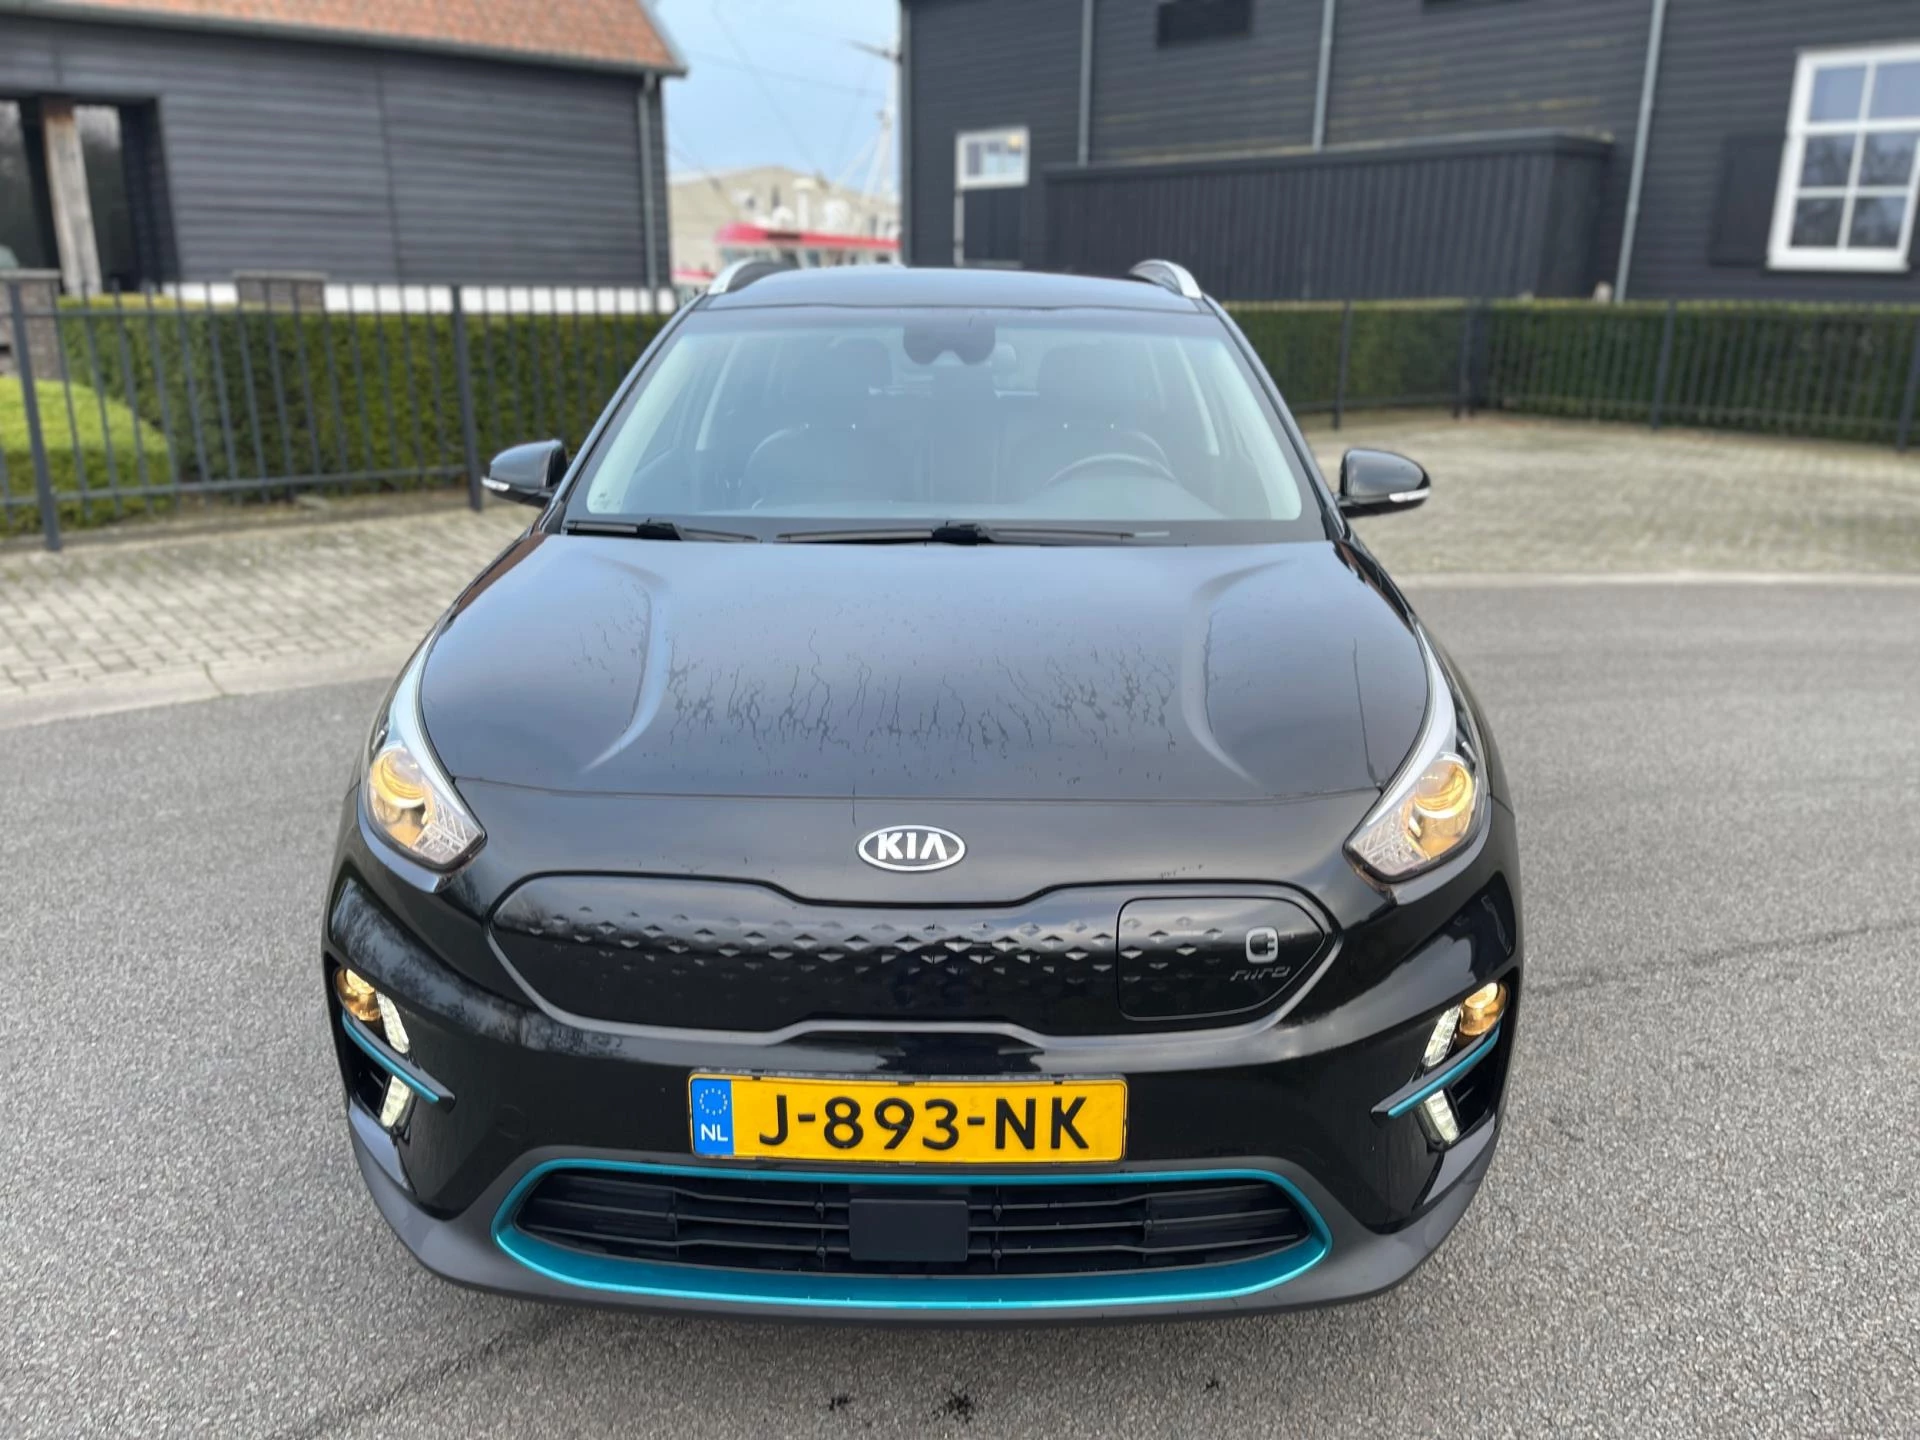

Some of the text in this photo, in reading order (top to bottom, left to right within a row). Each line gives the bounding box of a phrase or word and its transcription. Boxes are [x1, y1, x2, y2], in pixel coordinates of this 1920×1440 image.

[877, 831, 948, 860] KIA
[701, 1123, 728, 1142] NL
[759, 1094, 1089, 1150] J-893-NK
